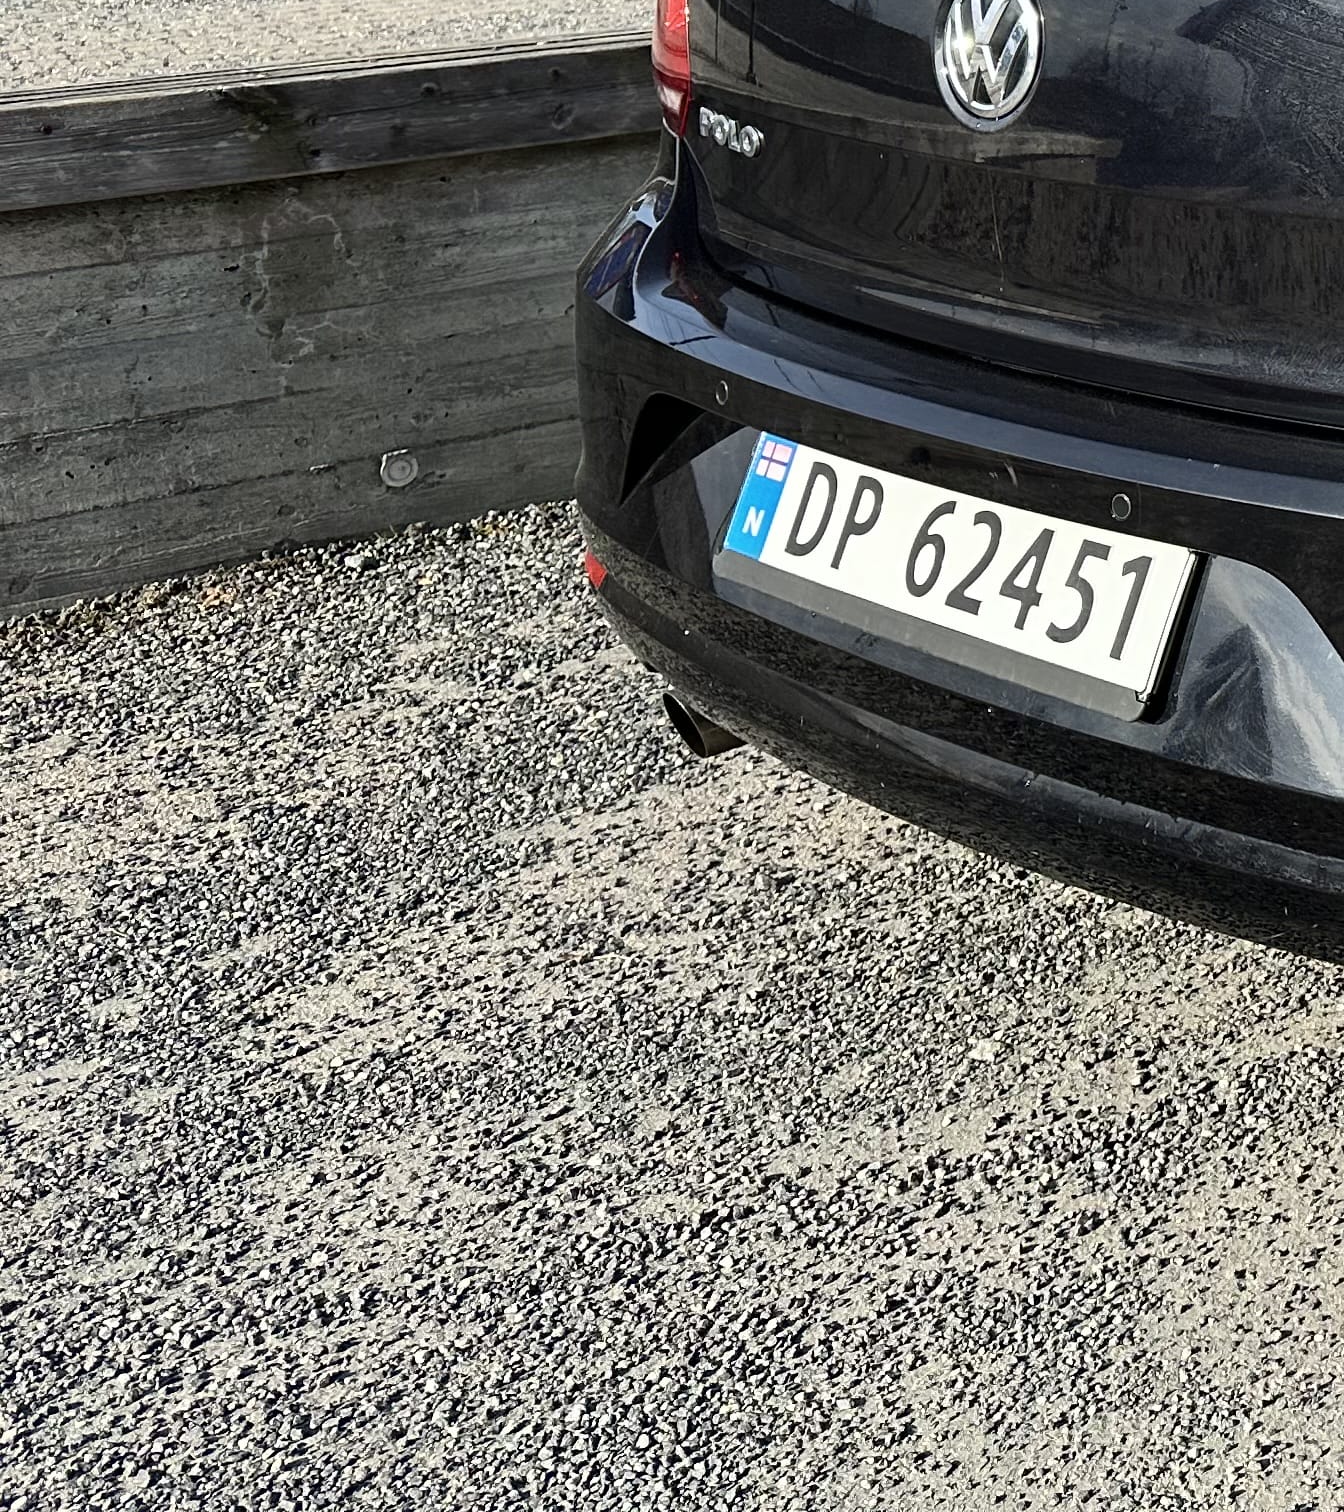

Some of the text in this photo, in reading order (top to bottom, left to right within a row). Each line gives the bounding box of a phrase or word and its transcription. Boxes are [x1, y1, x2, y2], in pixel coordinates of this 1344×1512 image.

[700, 106, 765, 159] POLO
[742, 507, 766, 538] N
[783, 461, 1154, 661] DP 62451
